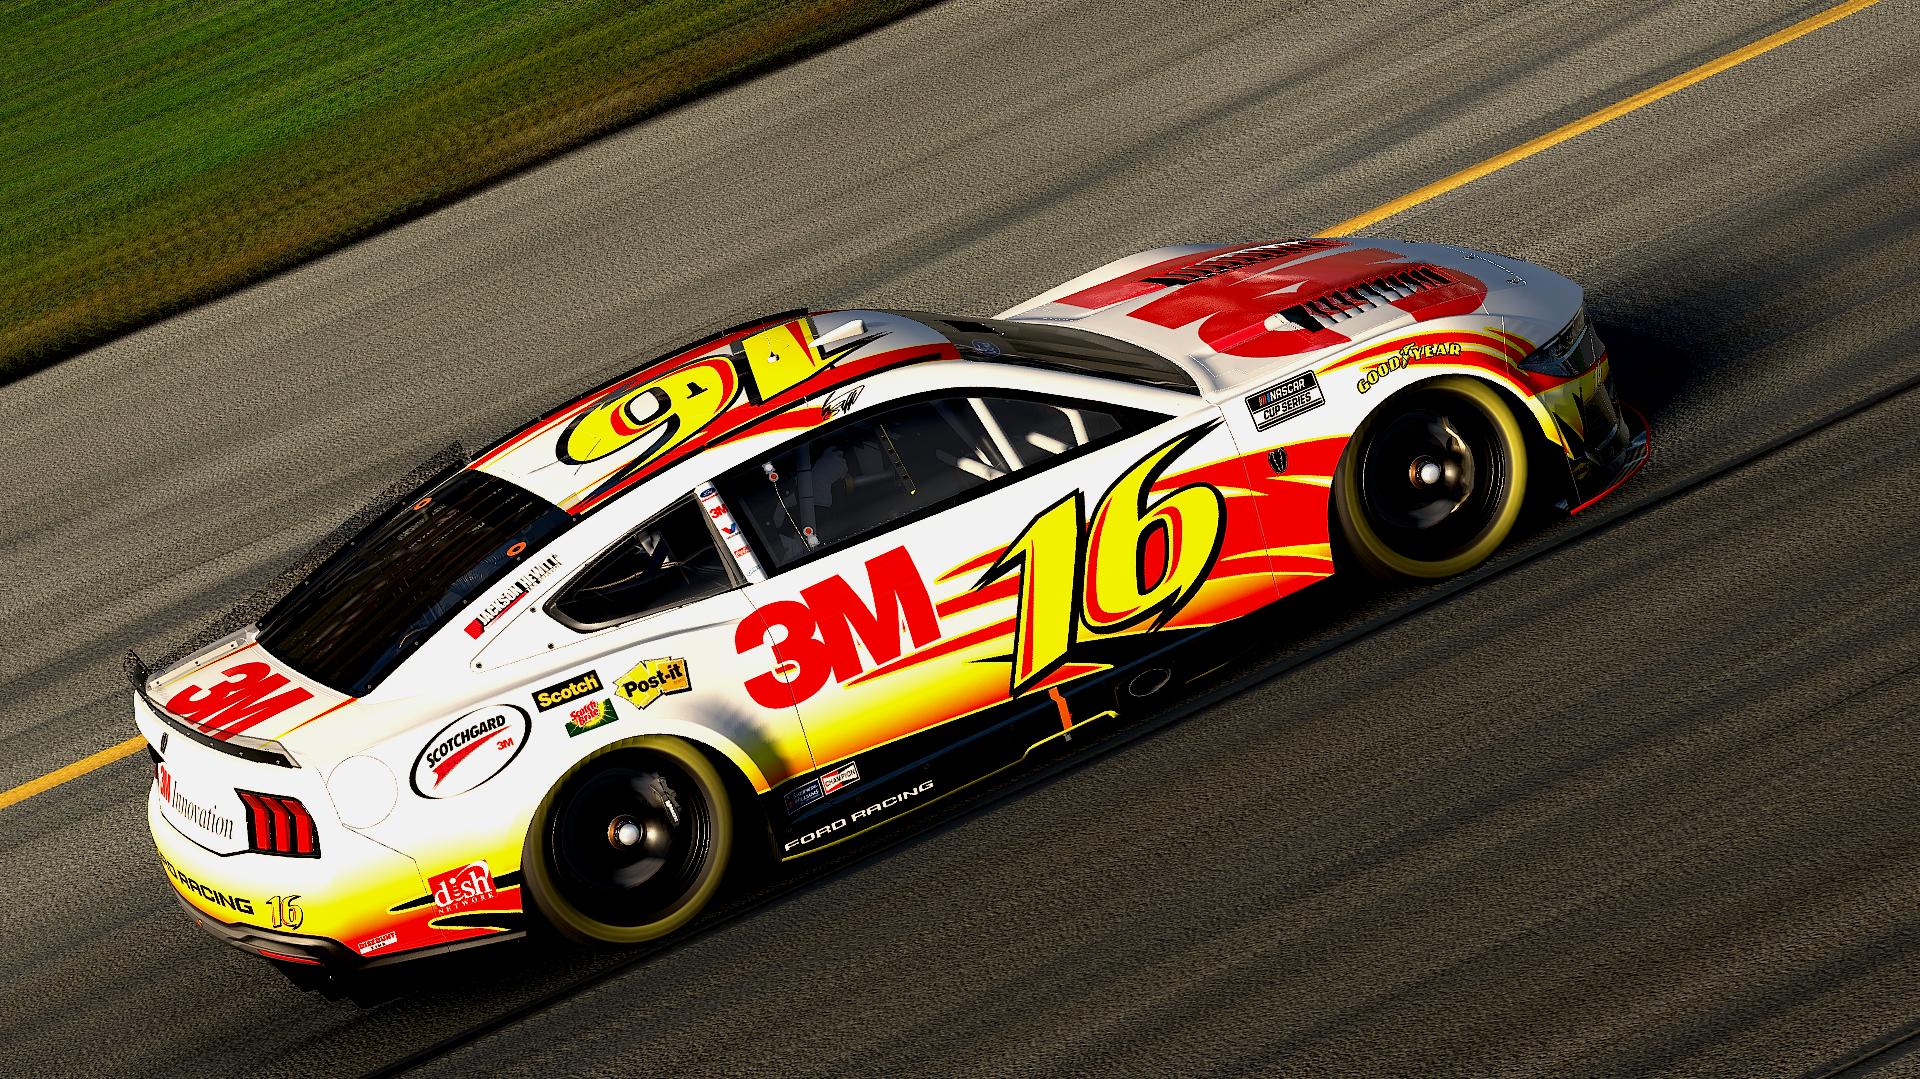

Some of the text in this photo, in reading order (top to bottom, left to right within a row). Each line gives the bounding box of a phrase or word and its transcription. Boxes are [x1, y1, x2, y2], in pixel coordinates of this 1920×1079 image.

[1357, 343, 1461, 394] GOODYEAR
[1263, 391, 1312, 421] CUP SERIES
[1269, 378, 1305, 402] NASCAR
[709, 503, 728, 519] 3M
[968, 416, 1226, 699] 16
[477, 583, 525, 626] JACKSON
[735, 545, 941, 709] 3M
[537, 674, 600, 708] Scotch
[622, 663, 683, 698] Post-it
[165, 662, 315, 741] 3M
[426, 714, 506, 769] SCOTCHGARD
[496, 737, 514, 751] 3M
[824, 768, 856, 788] CHAMPION
[172, 780, 233, 840] Innovation
[784, 779, 934, 852] FORD RACING
[177, 870, 254, 915] RACING
[437, 891, 495, 915] NETWORK
[265, 895, 304, 930] 16
